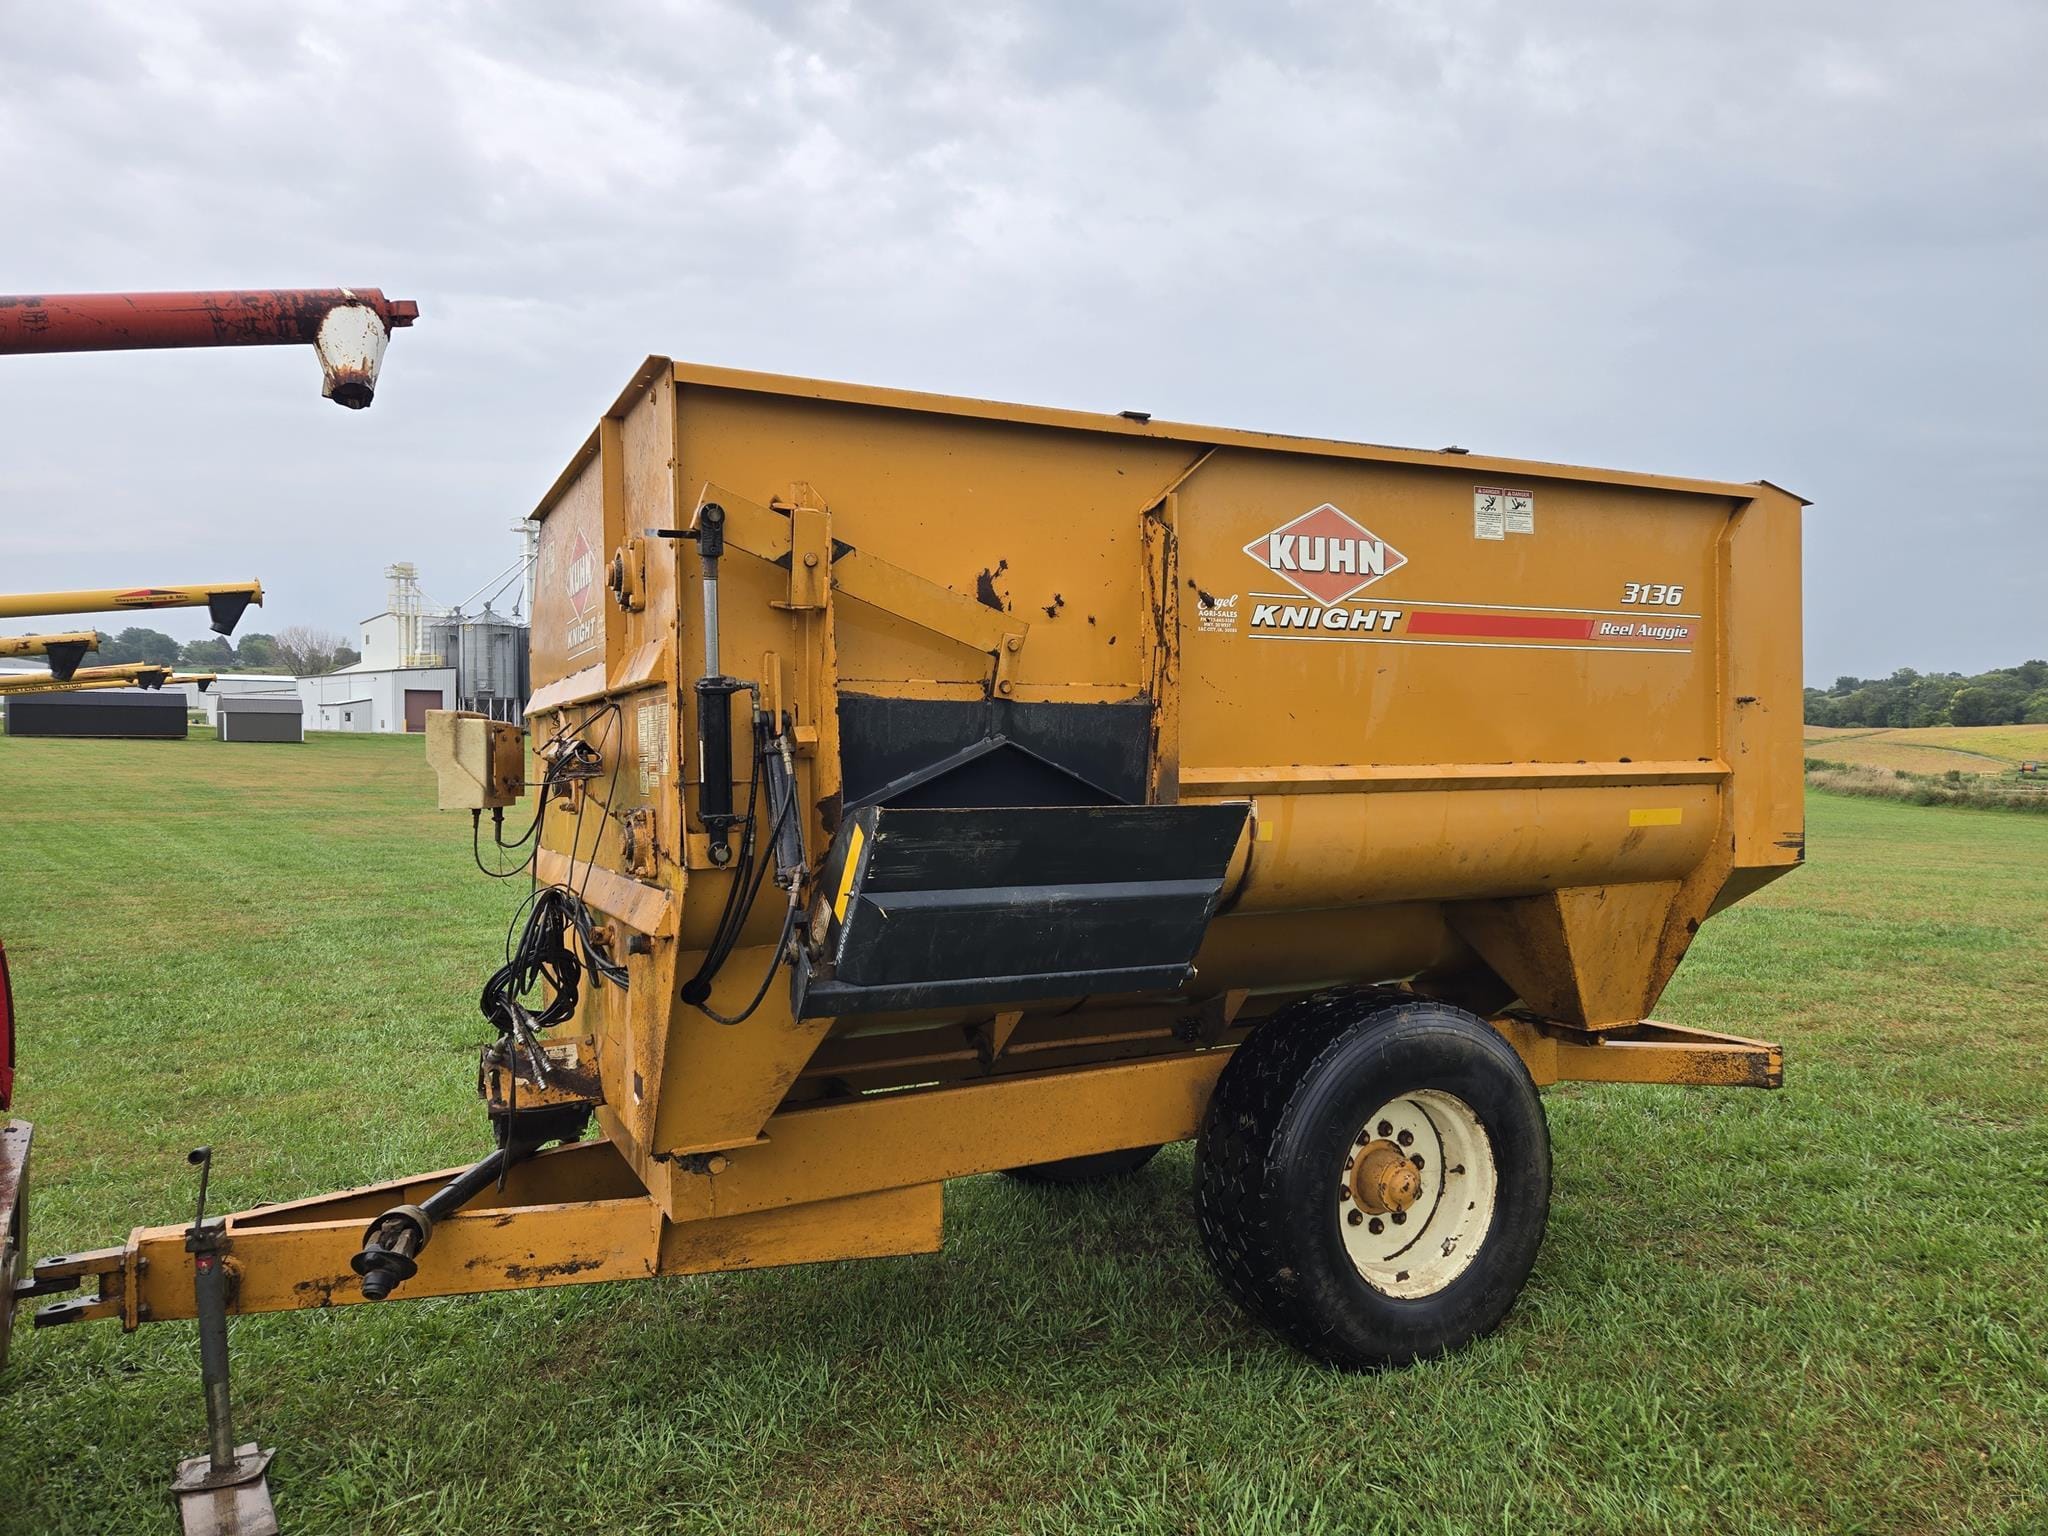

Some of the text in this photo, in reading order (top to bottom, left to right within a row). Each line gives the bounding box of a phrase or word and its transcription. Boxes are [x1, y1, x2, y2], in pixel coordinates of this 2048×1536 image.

[1269, 533, 1385, 575] KUHN
[568, 549, 592, 598] KUHN
[1621, 582, 1684, 606] 3136
[567, 616, 596, 651] KNIGHT
[1250, 603, 1402, 632] KNIGHT
[1600, 622, 1688, 641] Reel Auggie
